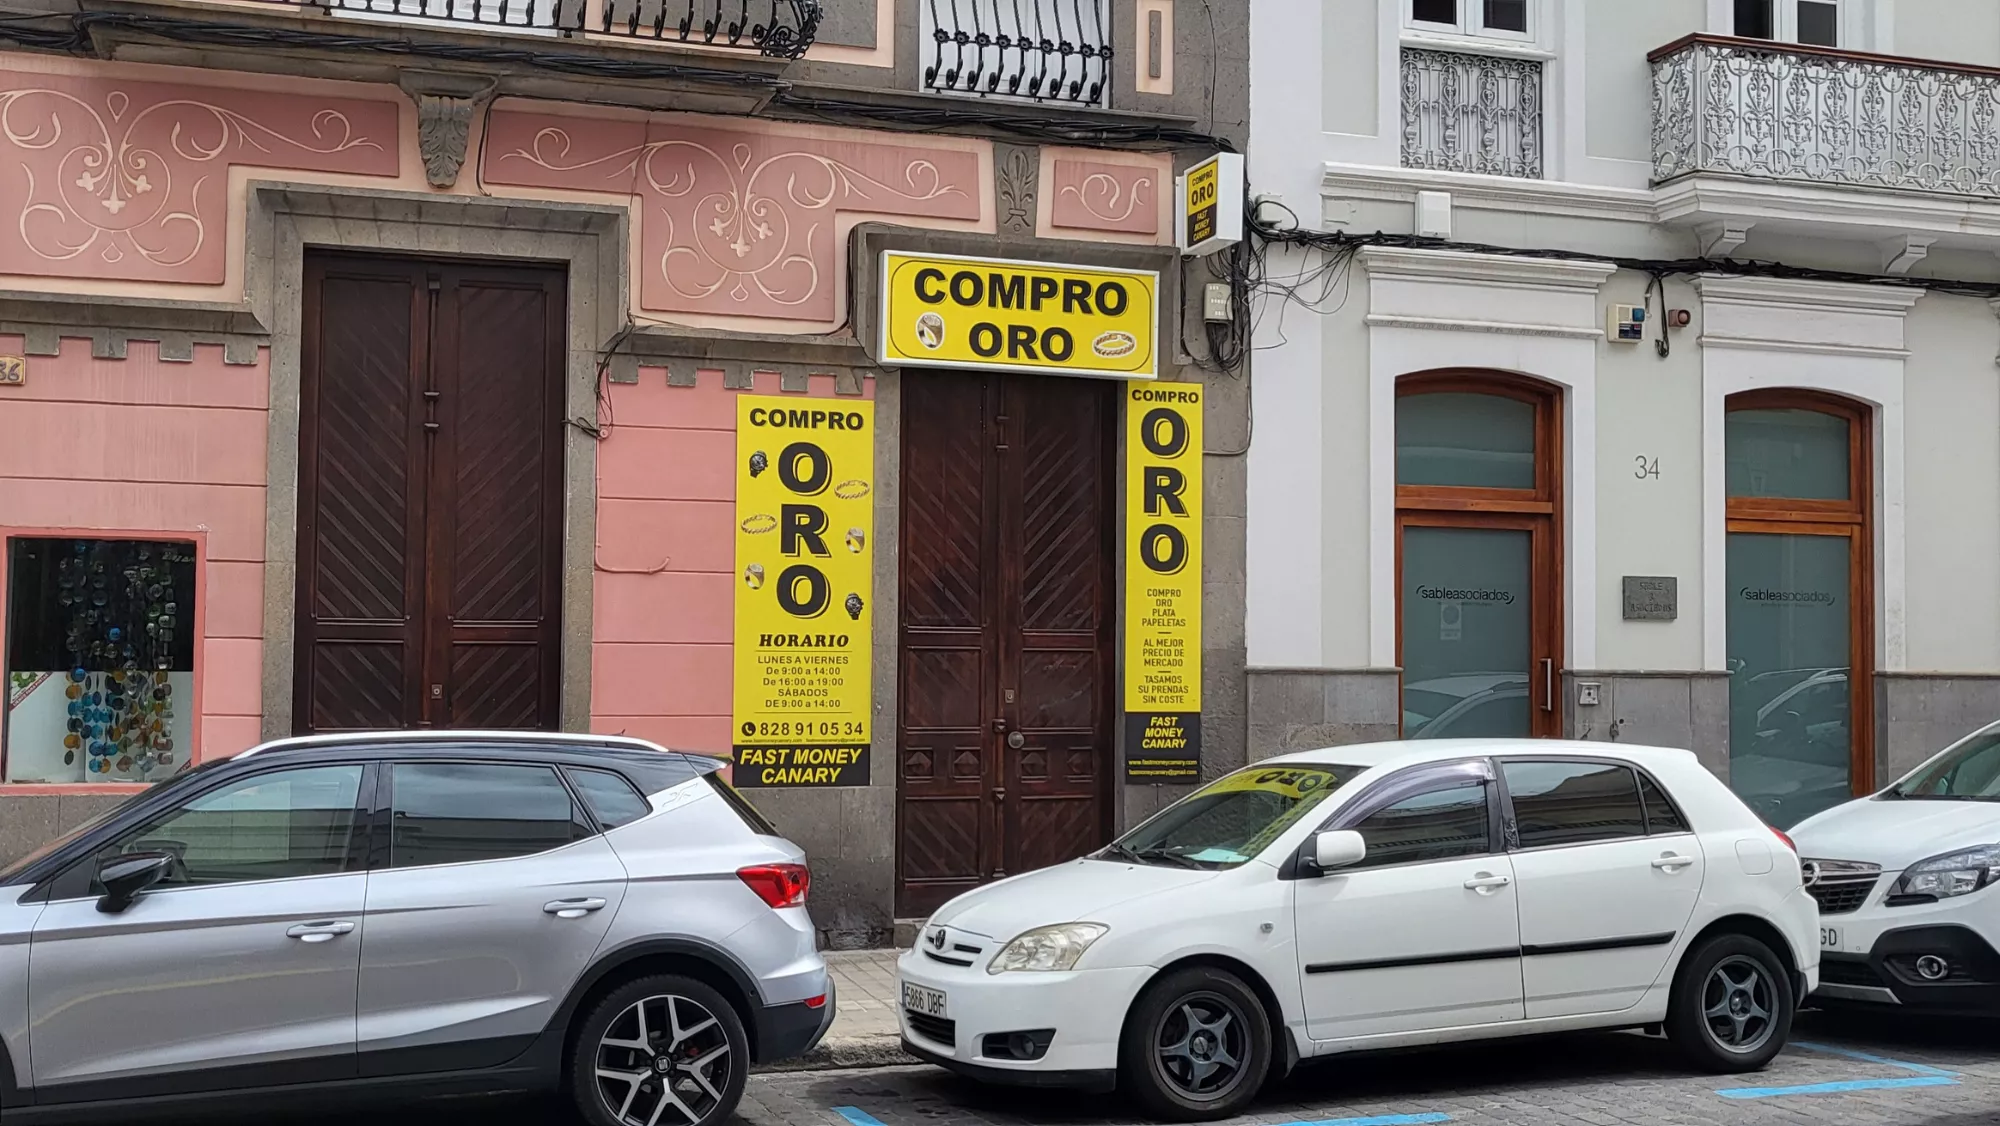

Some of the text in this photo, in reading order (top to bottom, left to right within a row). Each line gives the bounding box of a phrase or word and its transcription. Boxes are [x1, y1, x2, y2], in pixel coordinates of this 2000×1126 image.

[1192, 169, 1213, 187] COMPRO
[1191, 182, 1214, 206] ORO
[914, 268, 1129, 317] COMPRO
[968, 322, 1074, 362] ORO
[1131, 389, 1199, 404] COMPRO
[749, 407, 864, 431] COMPRO
[1635, 455, 1660, 480] 34
[1140, 407, 1190, 576] ORO
[777, 442, 833, 620] ORO
[1147, 588, 1182, 598] COMPRO
[1155, 599, 1173, 607] ORO
[1152, 608, 1176, 617] PLATA
[1141, 618, 1186, 627] PAPELETAS
[758, 634, 850, 648] HORARIO
[1143, 638, 1184, 648] AL MEJOR
[1142, 648, 1184, 657] PRECIO DE
[757, 656, 849, 665] LUNES A VIERNES
[1143, 658, 1183, 667] MERCADO
[766, 667, 779, 675] De
[781, 667, 803, 675] 9:00
[814, 667, 841, 675] 14:00
[763, 678, 776, 686] De
[779, 678, 806, 686] 16:00
[817, 678, 844, 686] 19:00
[1144, 675, 1183, 684] TASAMOS
[778, 687, 829, 697] SÁBADOS
[1138, 685, 1189, 694] SU PRENDAS
[765, 700, 780, 708] DE
[781, 700, 803, 708] 9:00
[814, 700, 841, 708] 14:00
[1142, 695, 1184, 704] SIN COSTE
[1150, 716, 1178, 727] FAST
[760, 722, 864, 736] 828 91 05 34
[1144, 727, 1184, 738] MONEY
[1142, 738, 1187, 749] CANARY
[740, 748, 862, 765] FAST MONEY
[761, 767, 842, 784] CANARY
[904, 985, 945, 1015] 5866 DBF
